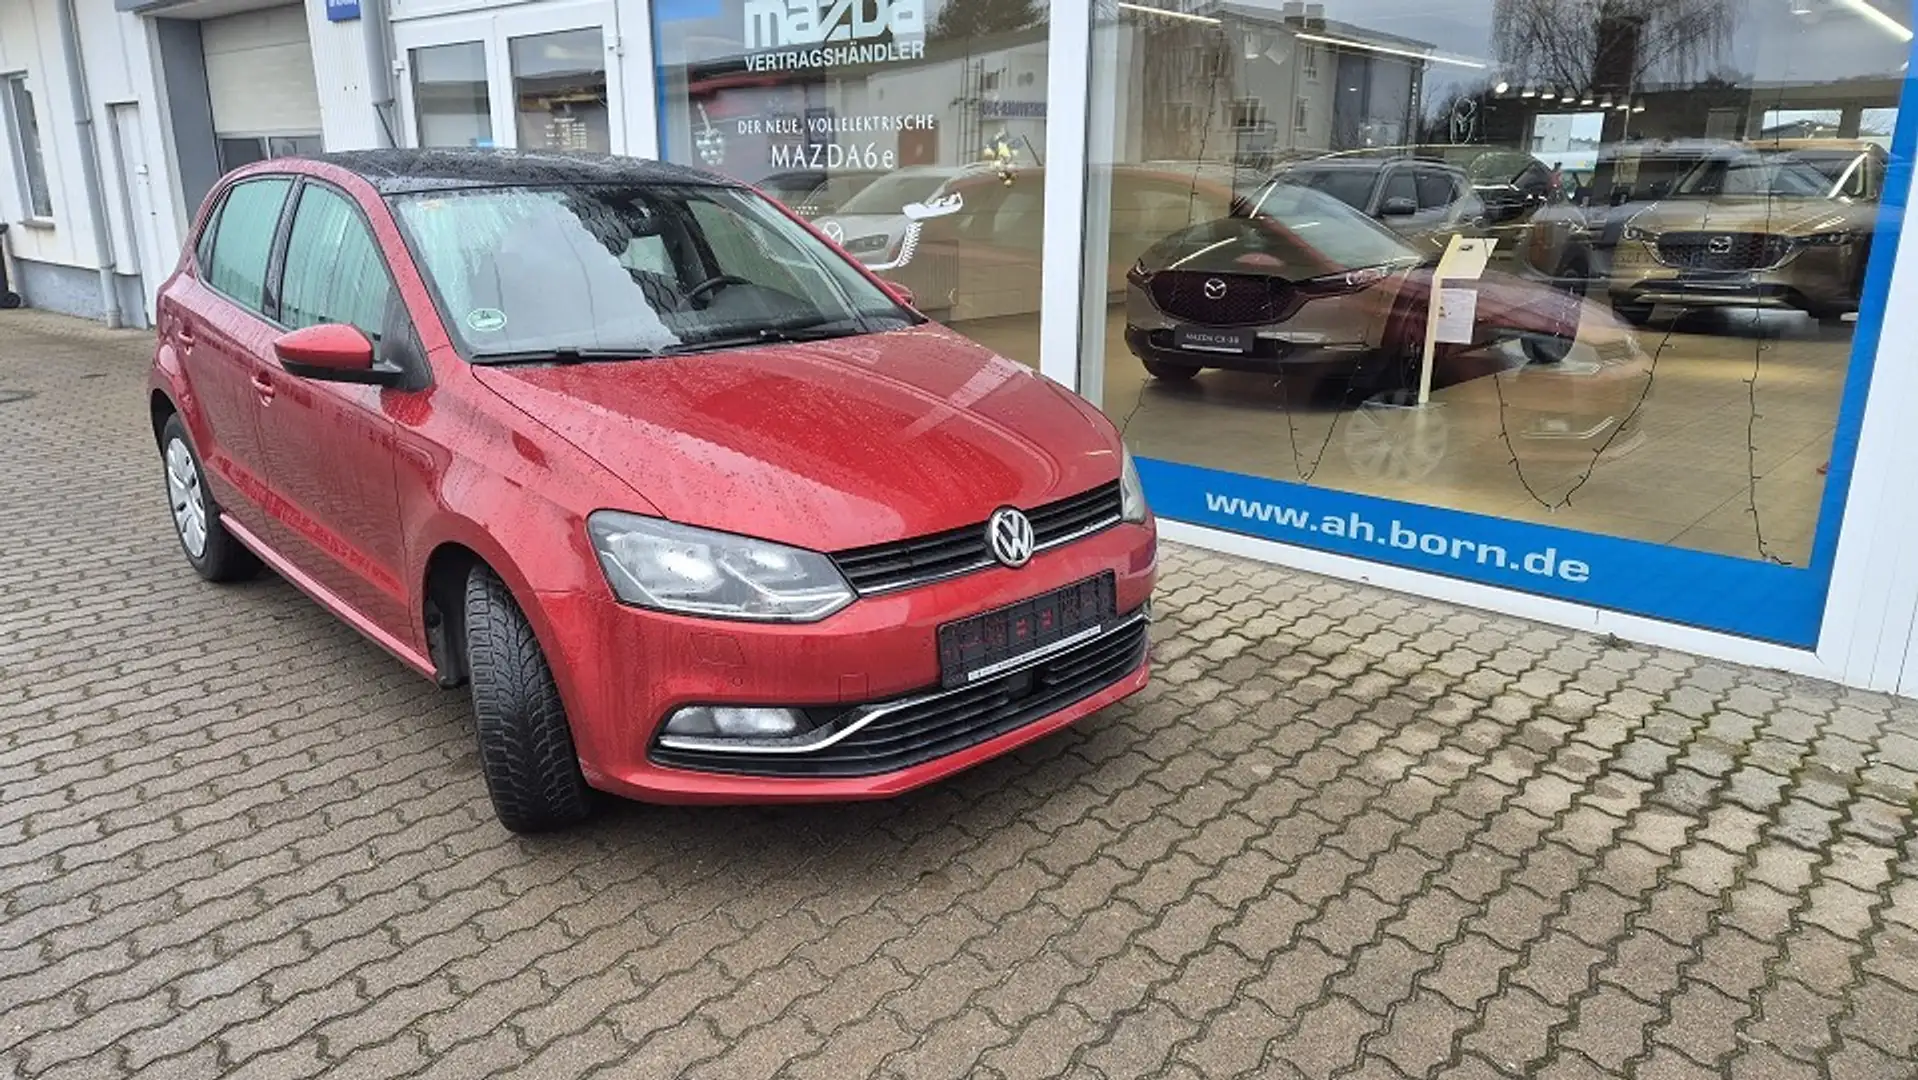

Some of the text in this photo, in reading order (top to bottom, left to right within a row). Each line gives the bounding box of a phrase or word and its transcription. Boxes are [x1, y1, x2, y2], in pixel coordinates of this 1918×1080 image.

[744, 41, 926, 72] VERTRAGSHÄNDLER
[737, 119, 762, 134] DER
[807, 114, 935, 133] VOLLELEKTRISCHE
[771, 142, 894, 169] MAZDA6e
[1205, 491, 1591, 583] www.ah.born.de
